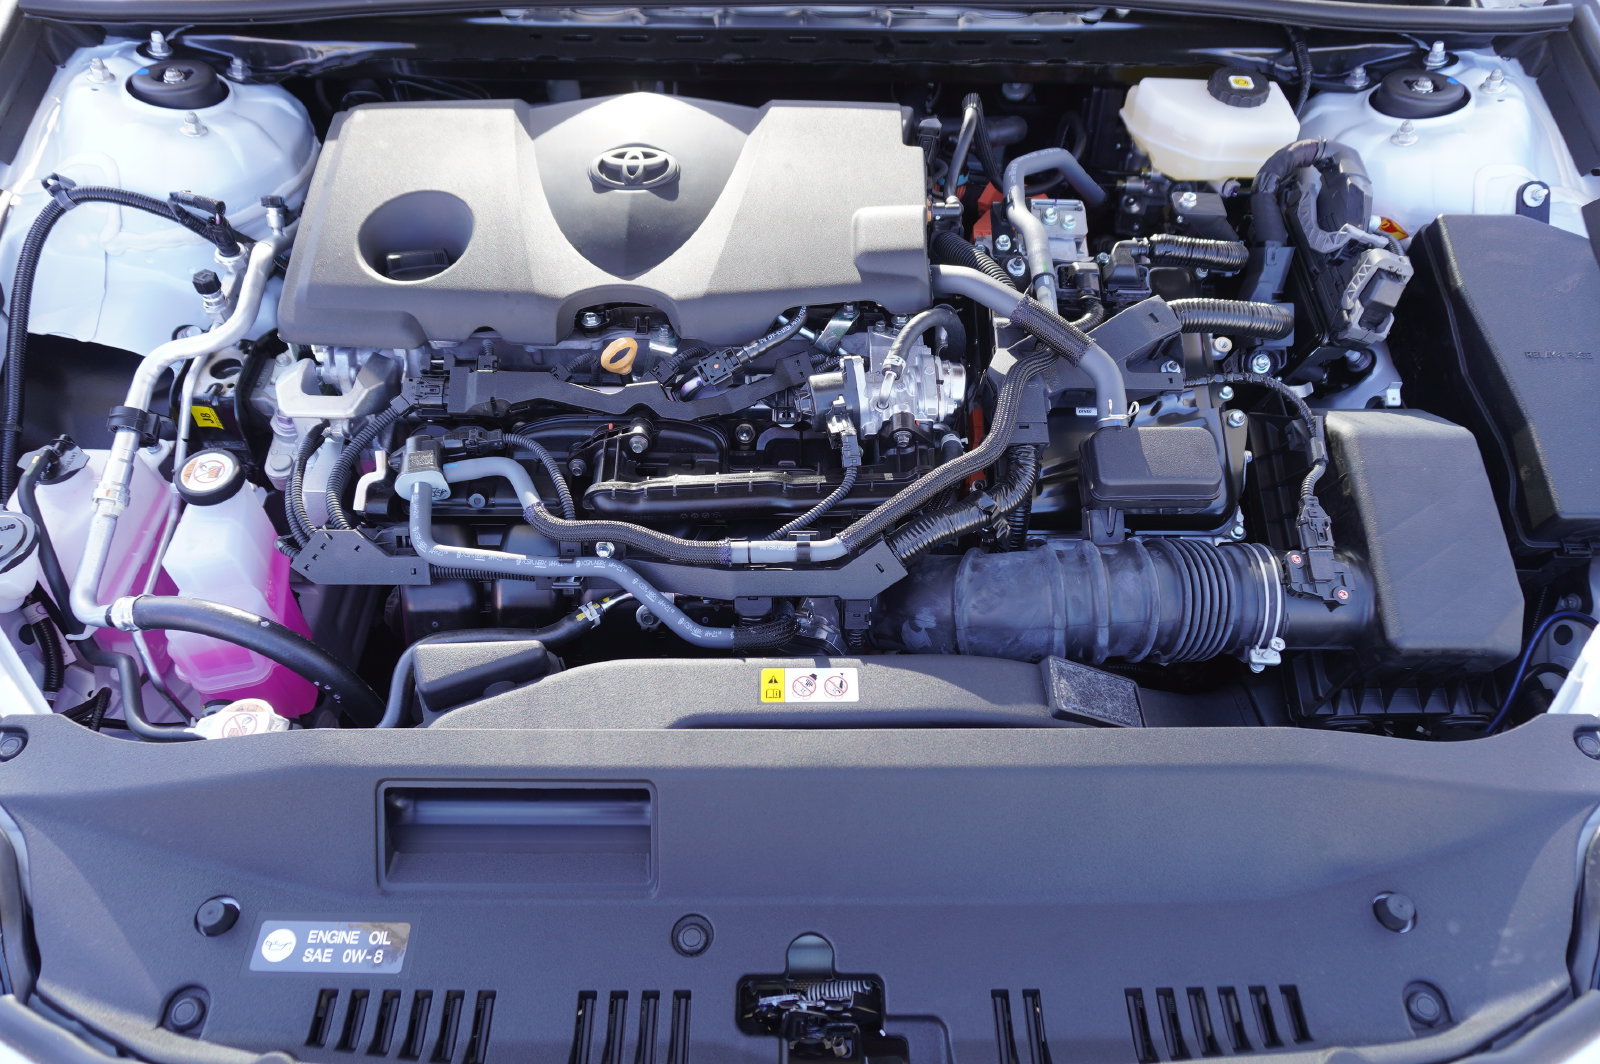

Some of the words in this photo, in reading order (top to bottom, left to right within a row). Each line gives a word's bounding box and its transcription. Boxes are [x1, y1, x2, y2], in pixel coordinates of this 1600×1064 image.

[307, 930, 360, 945] ENGINE
[369, 931, 391, 945] OIL
[302, 948, 333, 963] SAE
[342, 948, 384, 964] 0W-8
